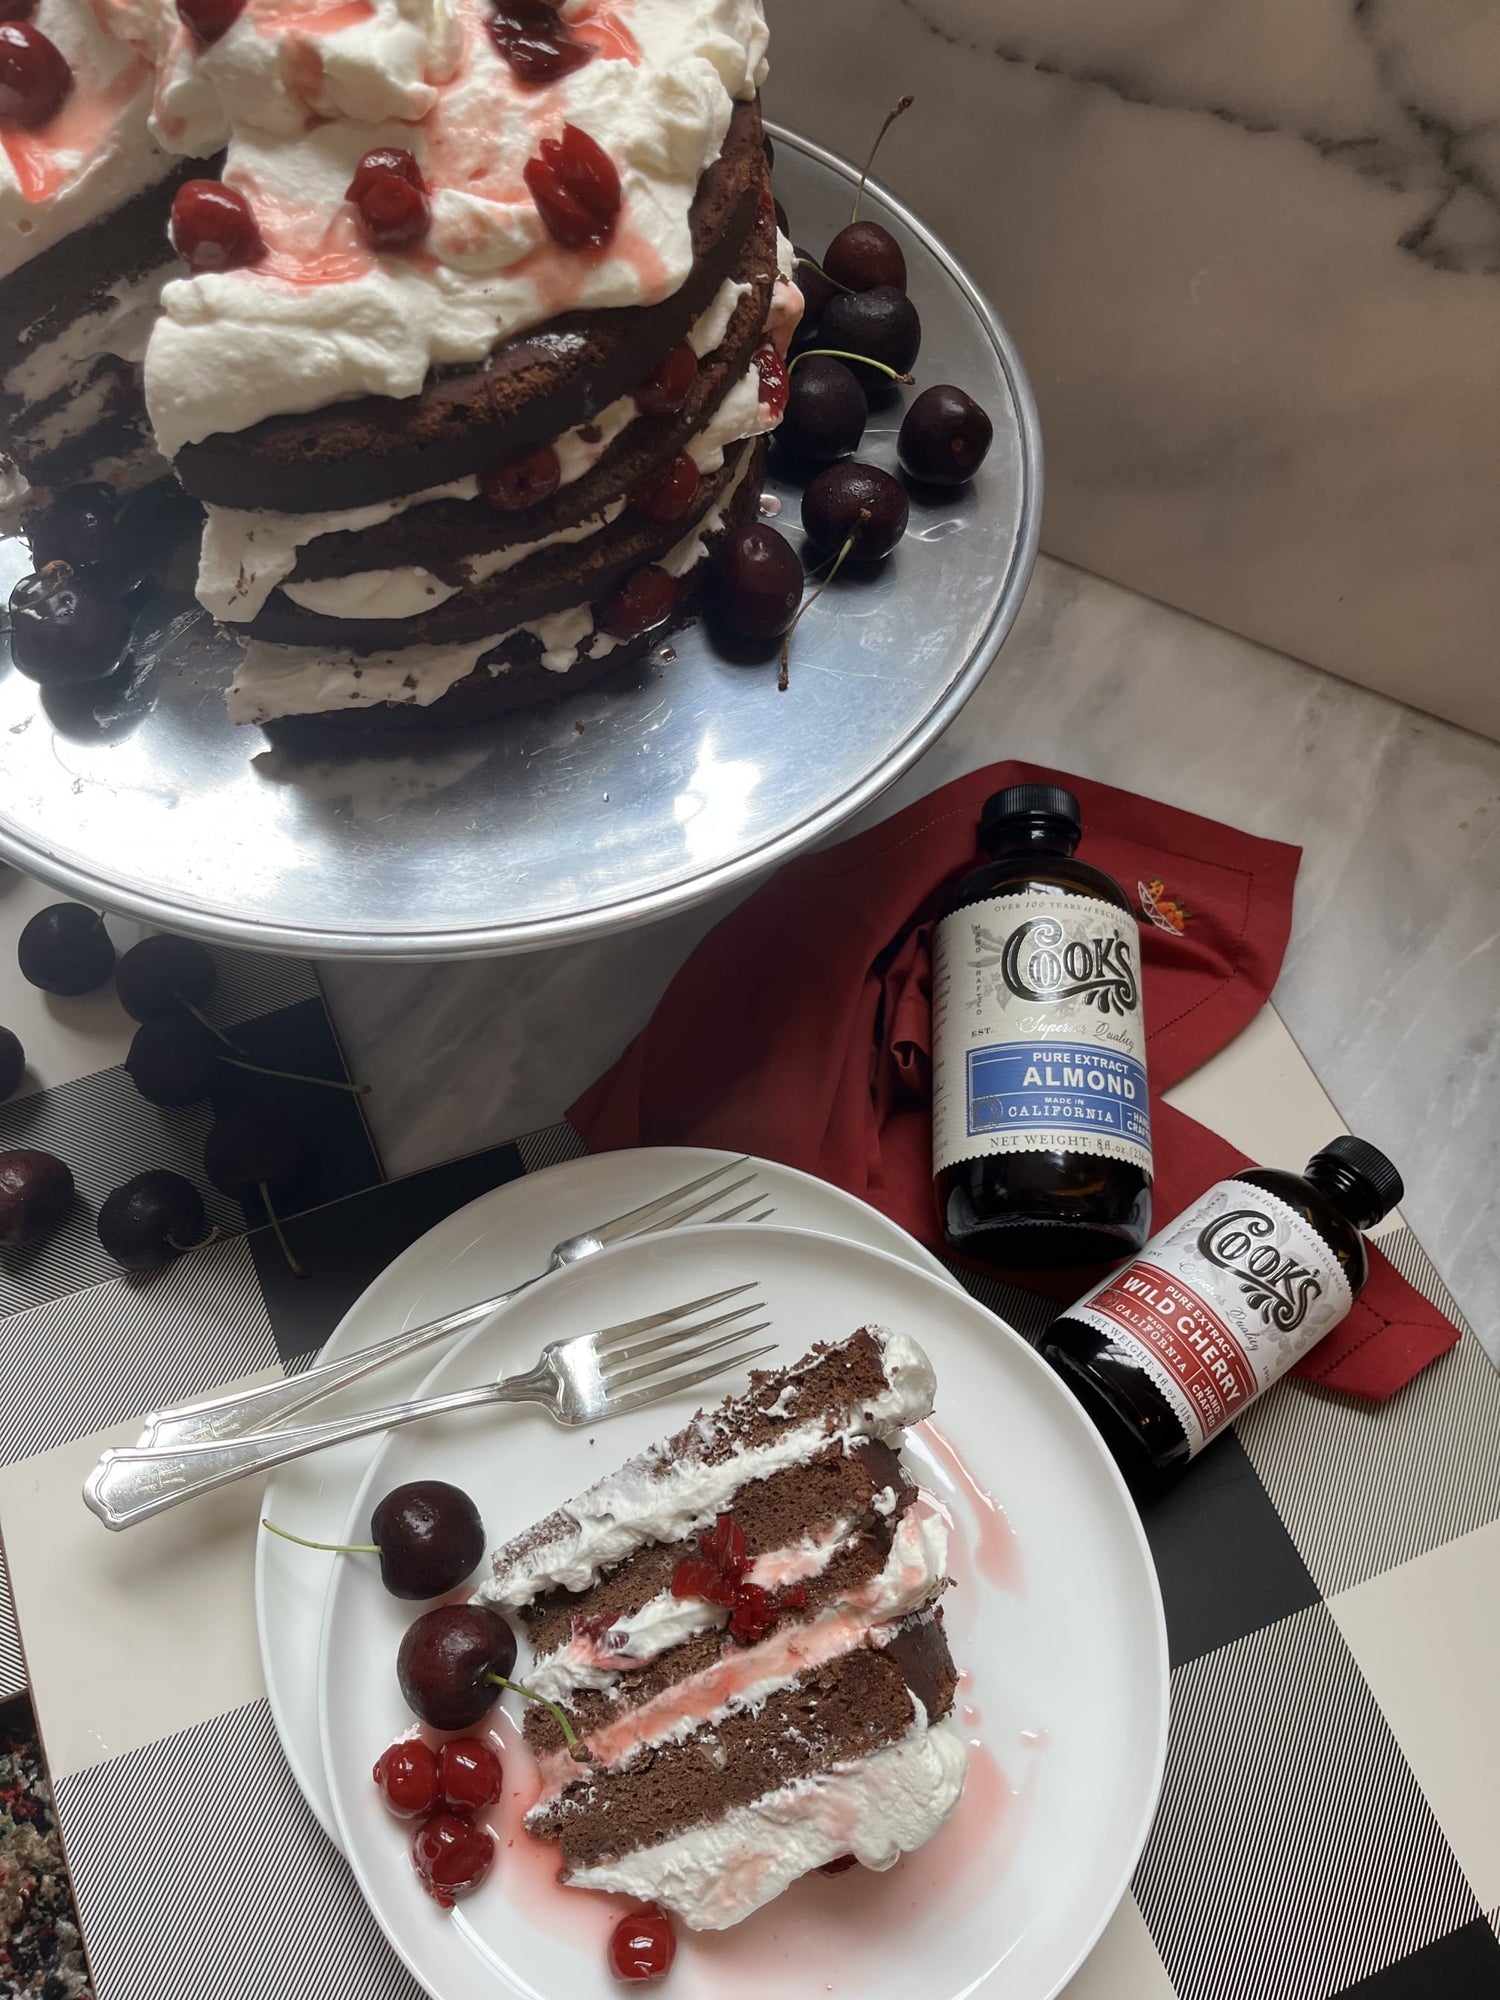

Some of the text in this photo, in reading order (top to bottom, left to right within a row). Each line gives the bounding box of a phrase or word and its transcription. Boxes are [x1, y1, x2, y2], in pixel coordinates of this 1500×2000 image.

[993, 903, 1020, 913] OVER
[1025, 901, 1045, 909] 100
[1050, 902, 1081, 911] YEARS
[1001, 916, 1137, 1012] COOK'S
[971, 1027, 994, 1038] EST.
[1093, 1020, 1135, 1054] Quality
[1032, 1052, 1129, 1075] PURE EXTRACT
[1022, 1066, 1136, 1100] ALMOND
[1044, 1096, 1085, 1106] MADE IN
[1007, 1105, 1115, 1123] CALIFORNIA
[990, 1135, 1019, 1149] NET
[1025, 1134, 1092, 1148] WEIGHT:
[1240, 1189, 1260, 1200] OVER
[1261, 1199, 1278, 1211] 100
[1279, 1211, 1302, 1233] YEARS
[1198, 1209, 1323, 1333] COOK'S
[1115, 1304, 1187, 1373] CALIFORNIA
[1122, 1276, 1176, 1315] WILD
[1176, 1315, 1241, 1402] CHERRY
[1146, 1315, 1174, 1342] MADE IN
[1164, 1285, 1195, 1311] PURE
[1192, 1309, 1236, 1360] EXTRACT
[1225, 1307, 1261, 1352] Quality
[1088, 1314, 1110, 1329] NET
[1110, 1326, 1155, 1371] WEIGHT:
[1191, 1384, 1216, 1427] CRAFTED
